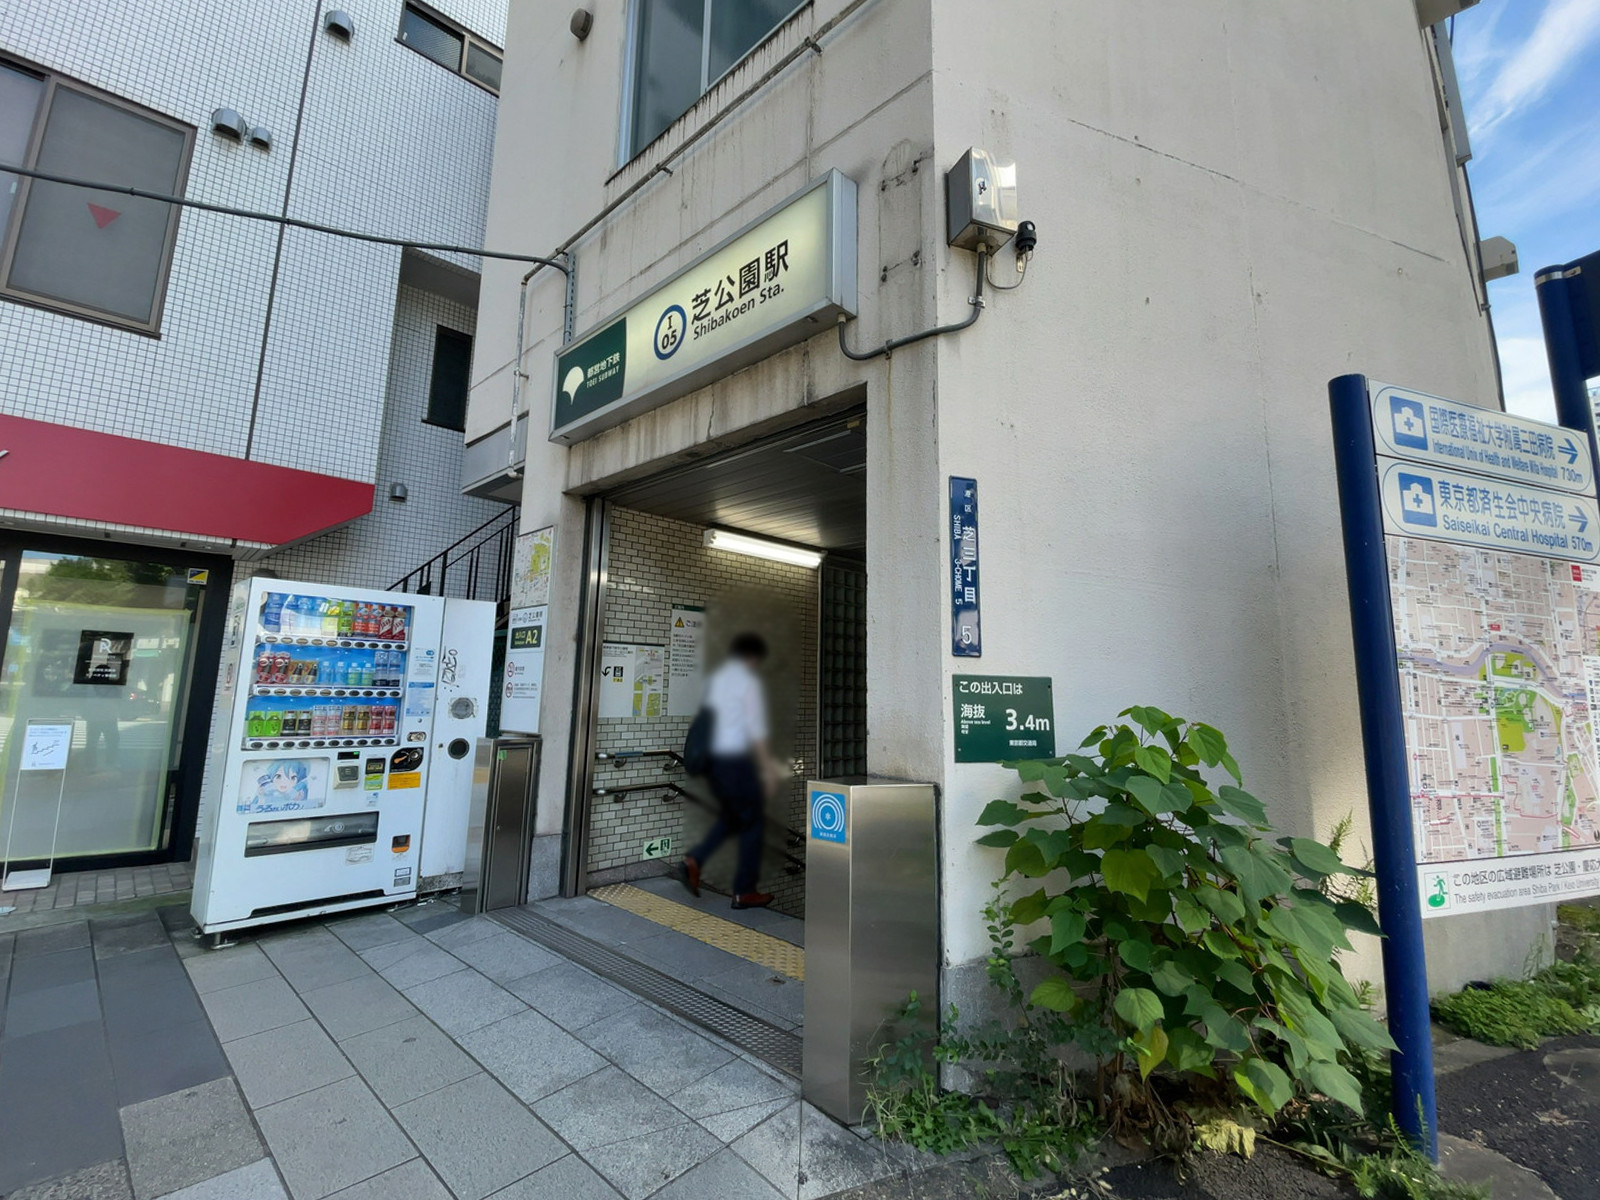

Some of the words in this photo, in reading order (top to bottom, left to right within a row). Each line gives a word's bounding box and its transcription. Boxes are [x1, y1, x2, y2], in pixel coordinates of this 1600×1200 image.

[691, 239, 789, 325] 芝公園駅
[667, 315, 673, 330] I
[693, 298, 755, 340] Shibakoen
[759, 283, 785, 304] Sta.
[661, 329, 677, 350] 05
[587, 352, 620, 378] 都営地下鉄
[586, 377, 598, 389] TOEI
[598, 365, 620, 383] SUBWAY
[1560, 466, 1583, 484] 730m
[1438, 480, 1566, 529] 東京都済生会中央病院
[953, 514, 962, 540] SHIBA
[1443, 514, 1491, 537] Saiseikai
[1493, 522, 1529, 543] Central
[1531, 529, 1568, 549] Hospital
[1571, 536, 1594, 553] 570m
[954, 558, 963, 593] 3-CHOME
[962, 526, 976, 604] 芝三丁目
[525, 629, 538, 645] A2
[962, 625, 972, 645] 5
[959, 681, 1023, 695] この出入口は
[960, 703, 986, 719] 海抜
[1005, 708, 1050, 731] 3.4m
[1454, 893, 1467, 904] The
[1487, 888, 1518, 901] evacuation
[1532, 883, 1548, 895] Shiba
